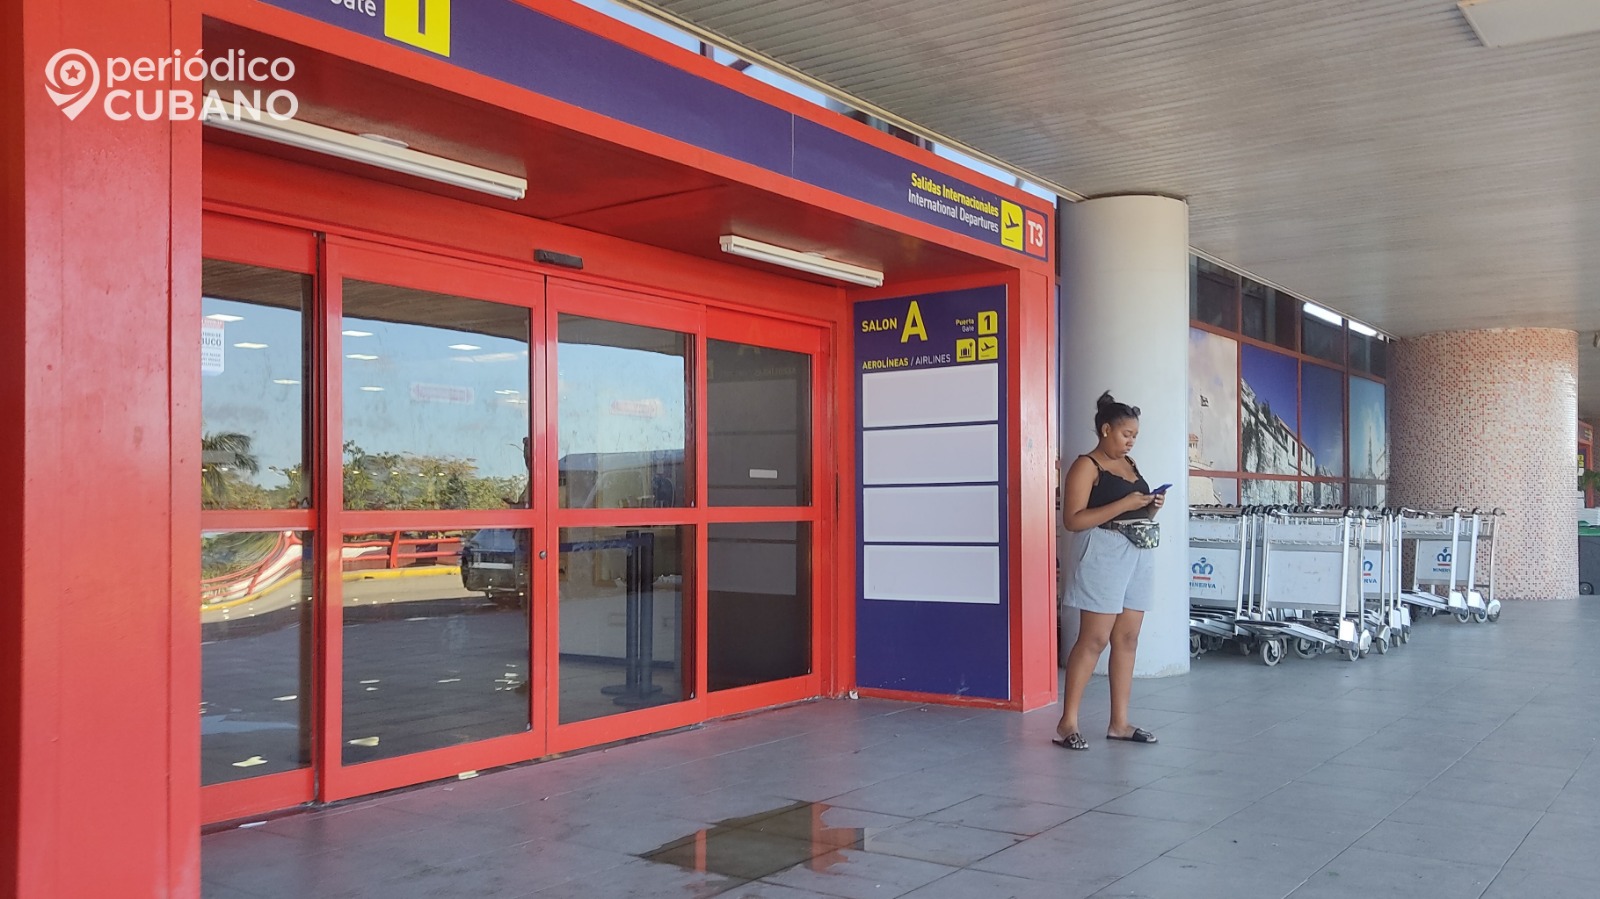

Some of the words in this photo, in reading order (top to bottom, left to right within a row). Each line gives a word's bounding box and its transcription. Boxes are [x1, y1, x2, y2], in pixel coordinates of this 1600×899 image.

[911, 172, 941, 196] Salidas
[942, 184, 999, 217] Internacionales
[908, 189, 958, 219] International
[959, 207, 999, 233] Departures
[1027, 220, 1044, 248] T3
[862, 317, 897, 332] SALON
[900, 300, 929, 344] A
[955, 318, 975, 326] Puerta
[961, 325, 975, 333] Gate
[984, 314, 991, 330] 1
[862, 357, 909, 370] AEROLÍNEAS
[915, 354, 951, 366] AIRLINES
